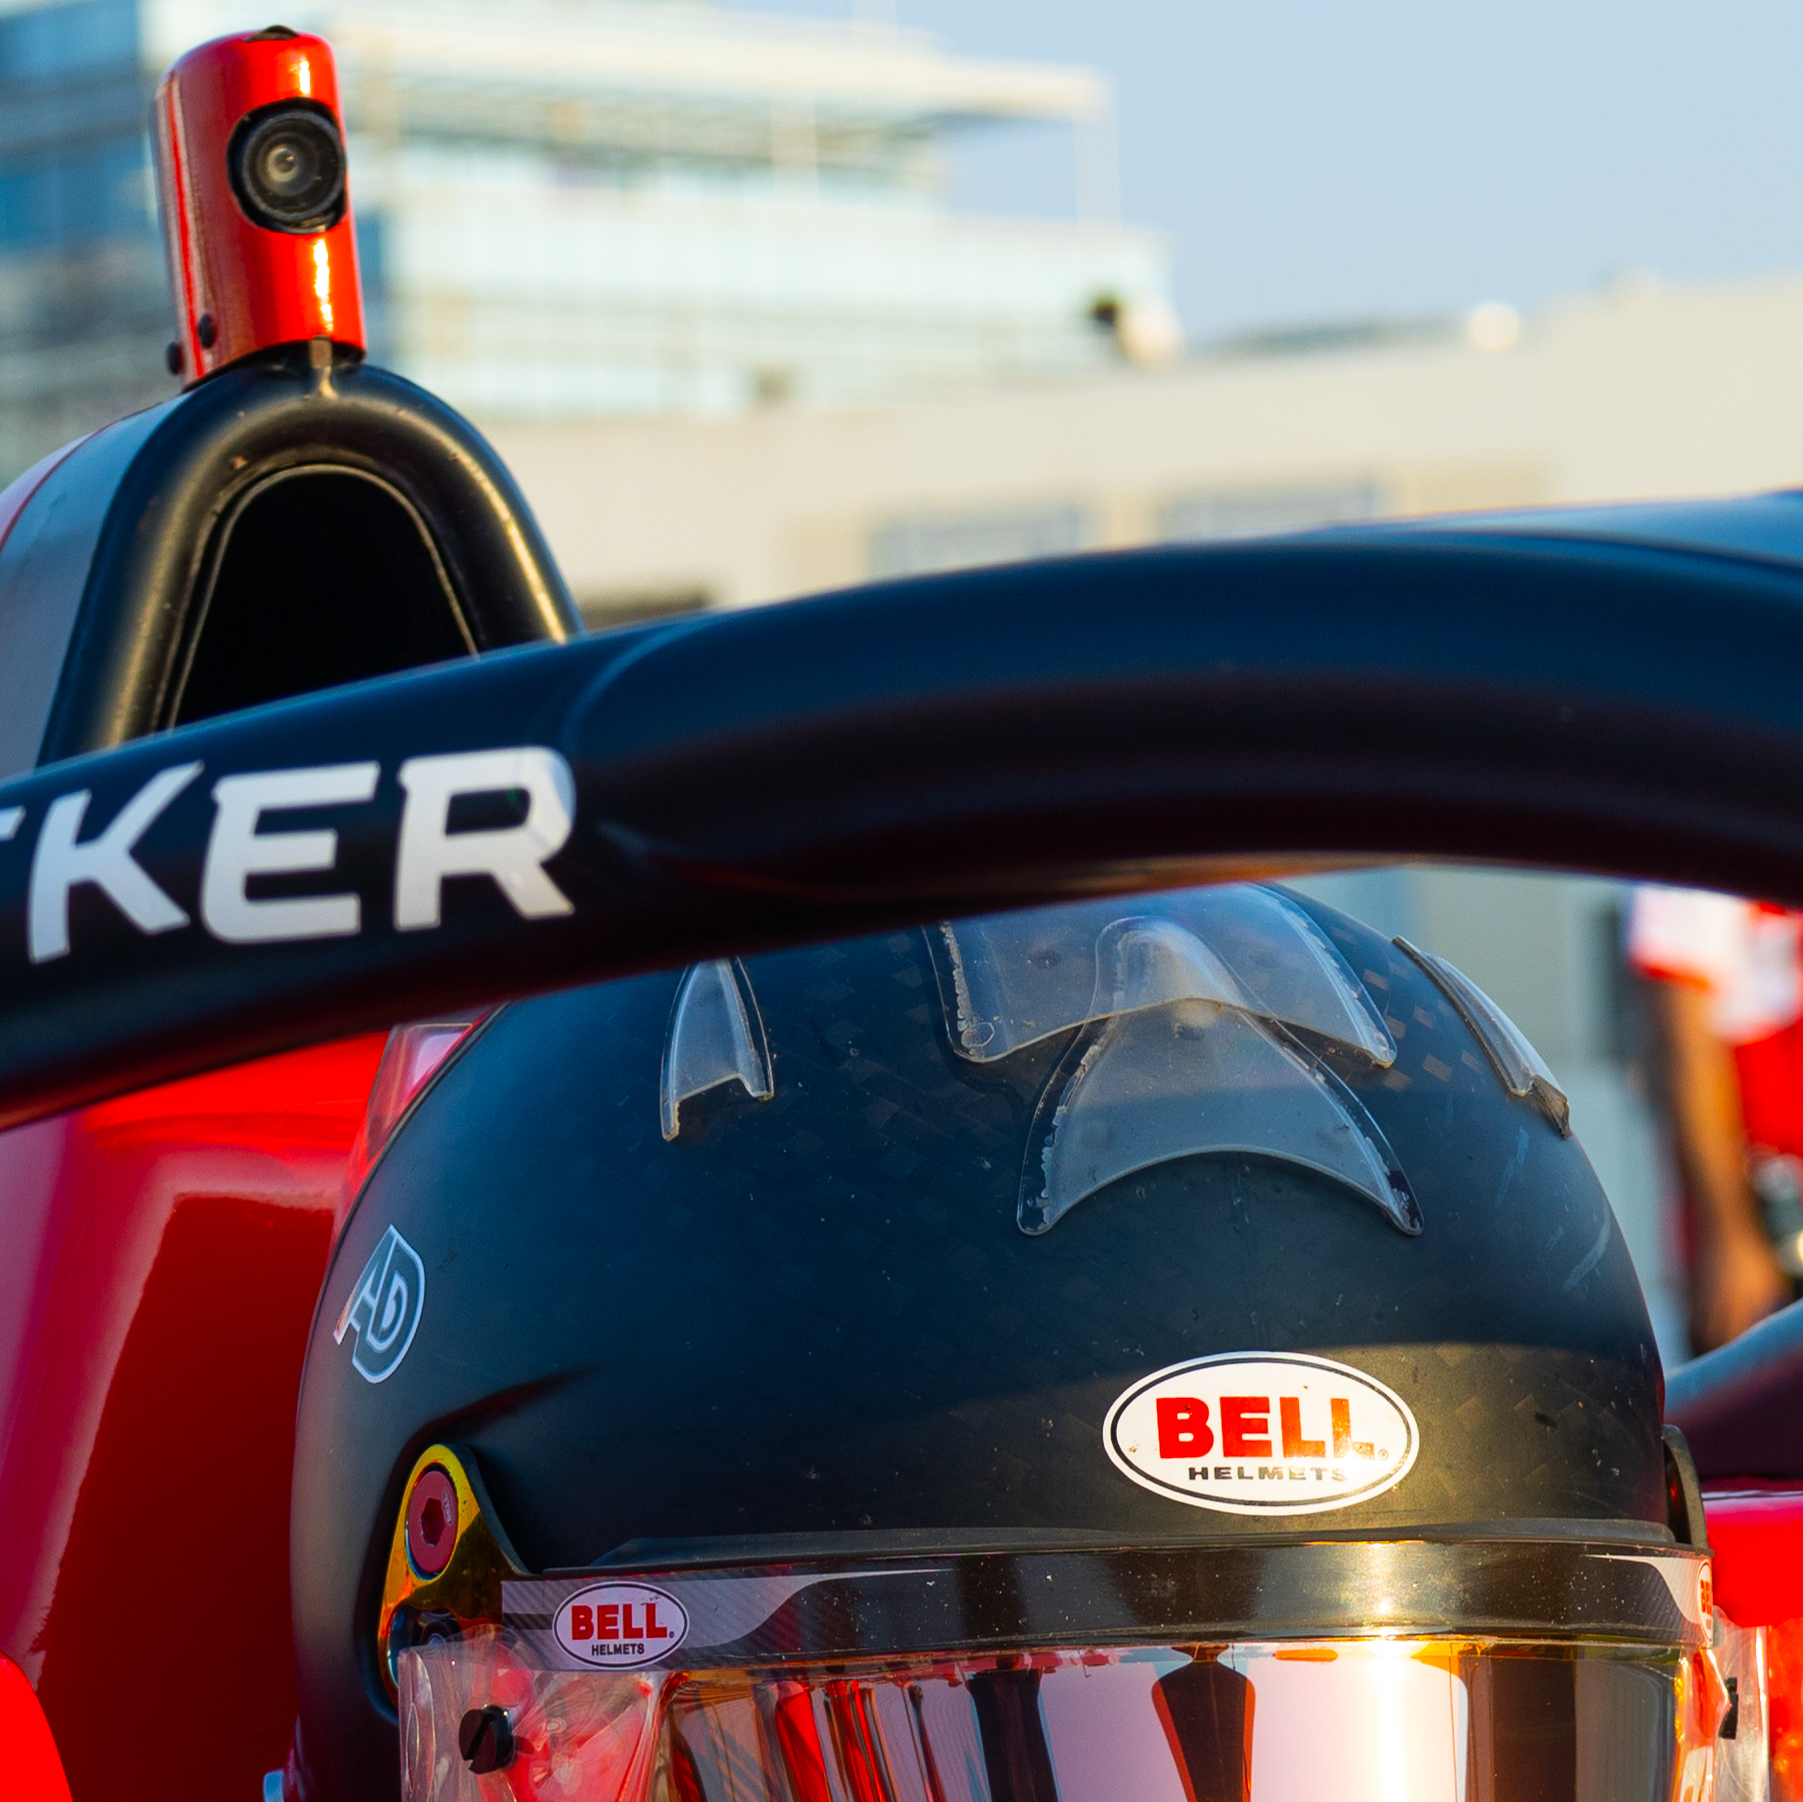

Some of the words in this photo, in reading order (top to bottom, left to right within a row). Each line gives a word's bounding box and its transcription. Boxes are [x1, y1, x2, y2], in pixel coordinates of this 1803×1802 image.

[1155, 1396, 1376, 1460] BELL
[1188, 1466, 1350, 1481] HELMETS
[571, 1603, 668, 1641] BELL
[591, 1643, 645, 1656] HELMETS
